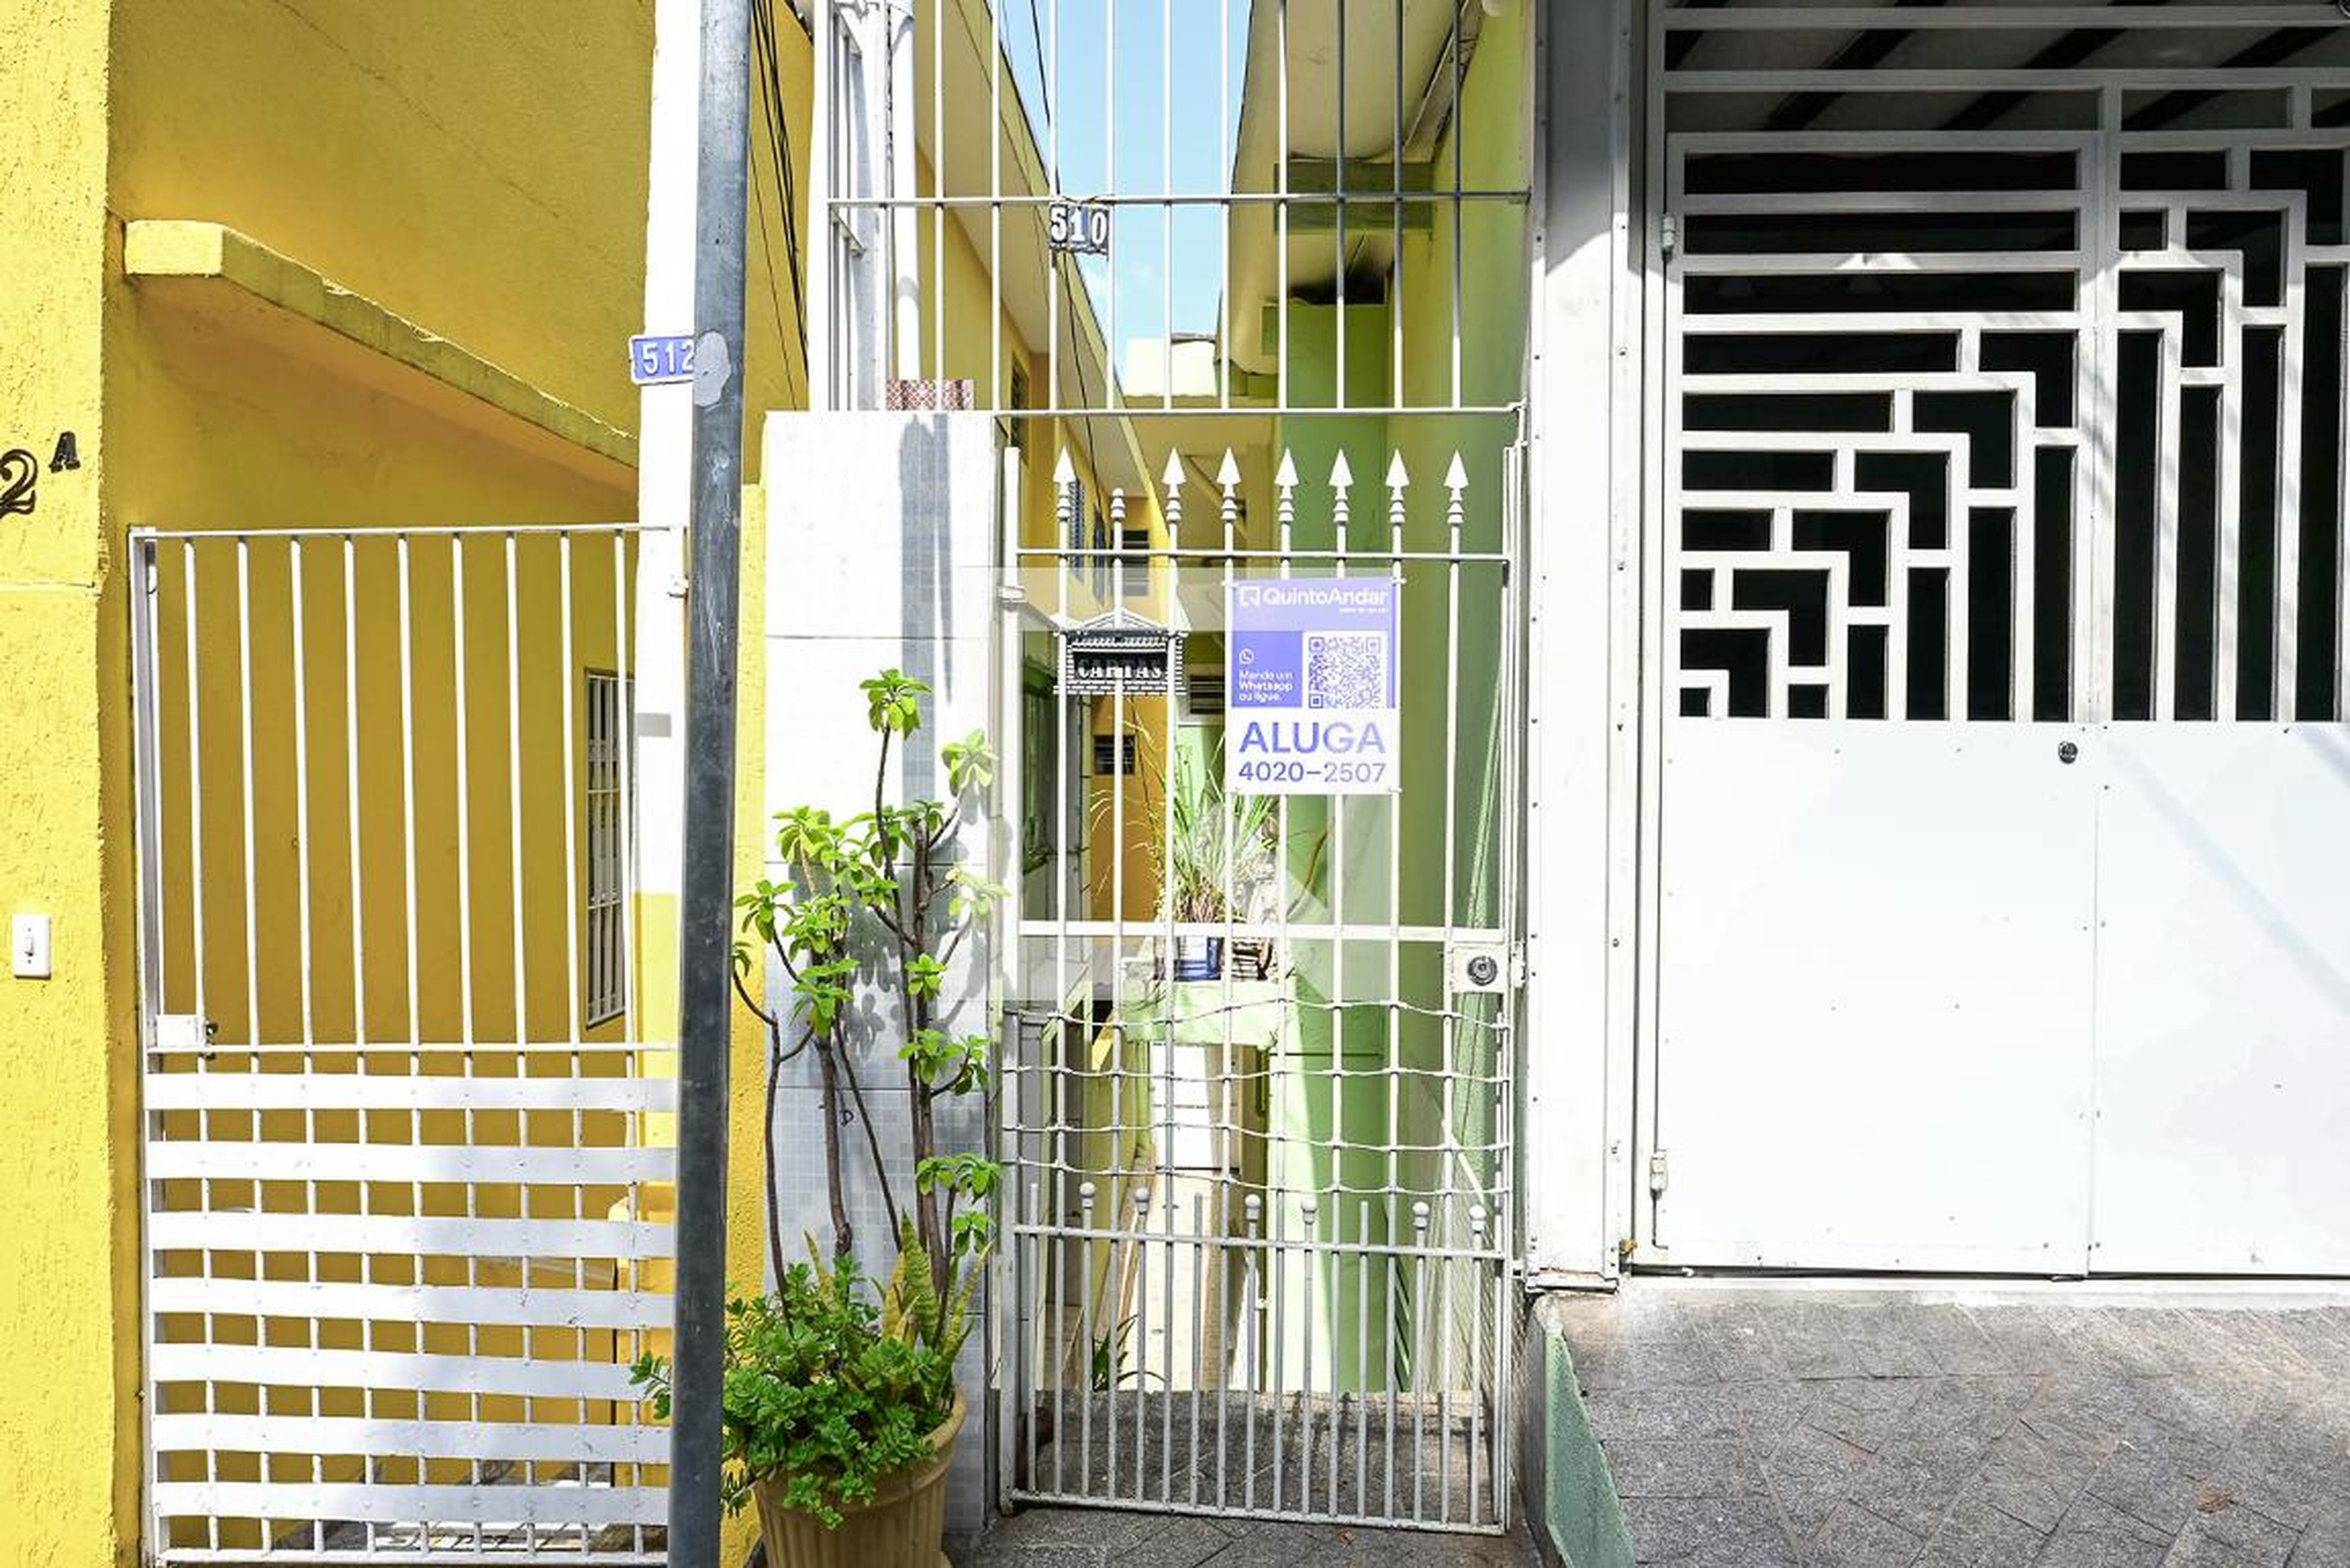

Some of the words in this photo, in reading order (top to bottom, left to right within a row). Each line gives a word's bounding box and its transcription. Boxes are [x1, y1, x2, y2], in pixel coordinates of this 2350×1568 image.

[1051, 206, 1107, 245] 510
[643, 340, 695, 375] 512
[1263, 586, 1389, 605] QuintoAndar
[1239, 722, 1386, 753] ALUGA
[1239, 761, 1387, 782] 4020-2507
